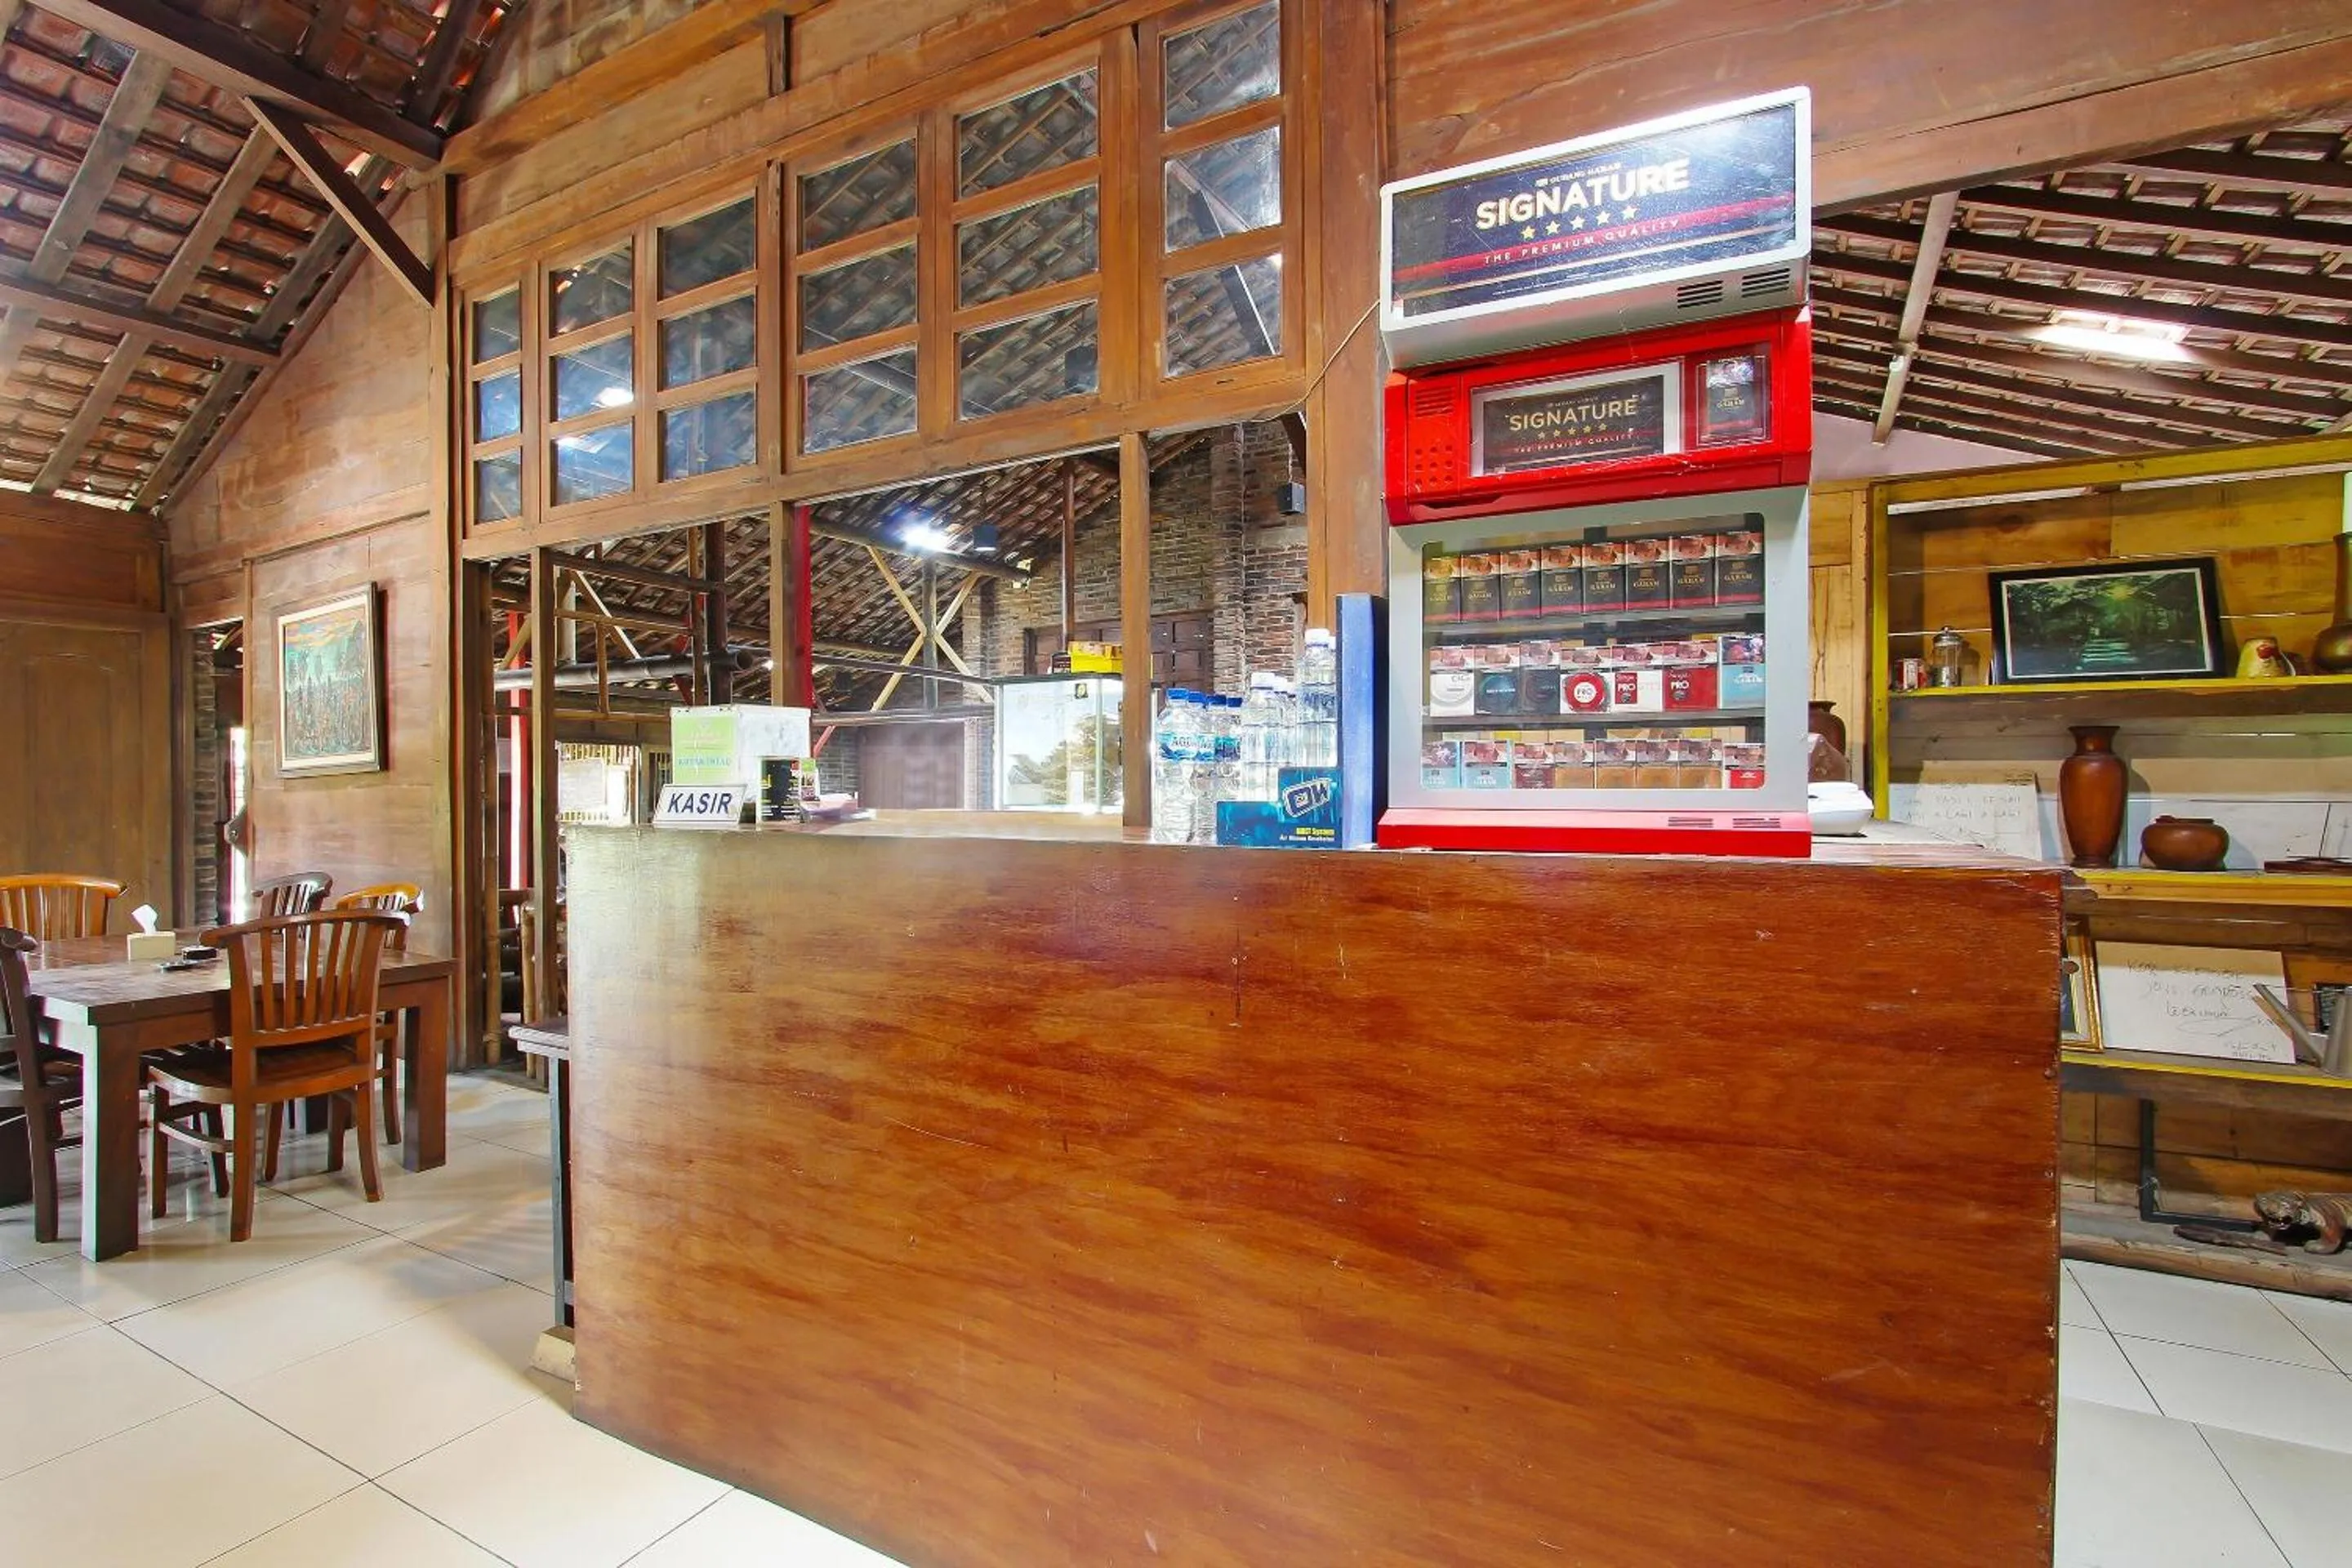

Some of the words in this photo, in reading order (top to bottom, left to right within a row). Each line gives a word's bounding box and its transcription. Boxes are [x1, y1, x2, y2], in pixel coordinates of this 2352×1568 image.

[1476, 156, 1690, 230] SIGNATURE
[1483, 252, 1511, 265] THE
[1521, 235, 1595, 257] PREMIUM
[1605, 219, 1680, 241] QUALITY
[1509, 398, 1640, 431] SIGNATURE
[1617, 682, 1637, 693] PRO
[1670, 679, 1690, 690] PRO
[666, 792, 733, 814] KASIR
